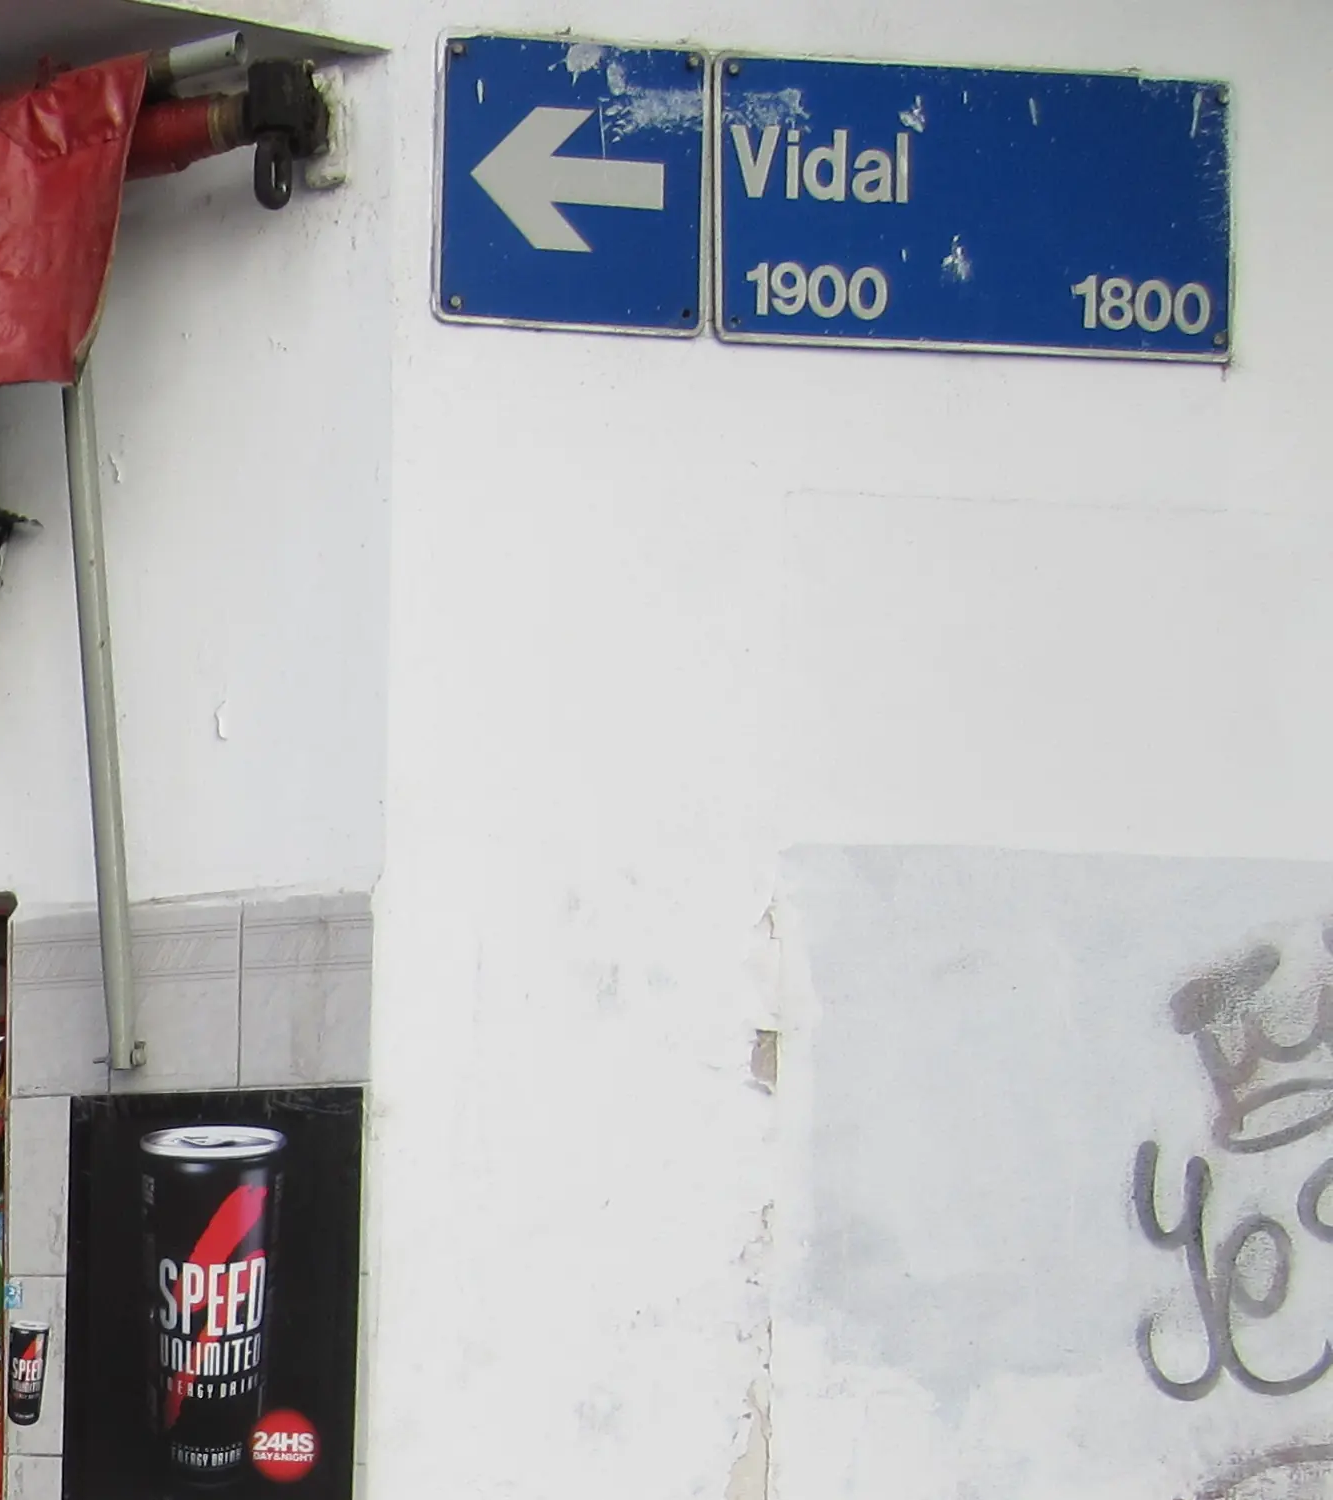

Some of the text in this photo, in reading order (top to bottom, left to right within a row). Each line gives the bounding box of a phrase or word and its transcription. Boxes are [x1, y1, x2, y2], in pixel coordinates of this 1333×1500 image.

[730, 122, 910, 206] Vidal
[746, 261, 1211, 336] 1900 1800
[159, 1256, 267, 1338] SPEED
[12, 1357, 44, 1382] SPEED
[160, 1333, 262, 1377] UNLIMITED
[252, 1430, 315, 1454] 24HS
[252, 1452, 315, 1464] DAY&NIGHT
